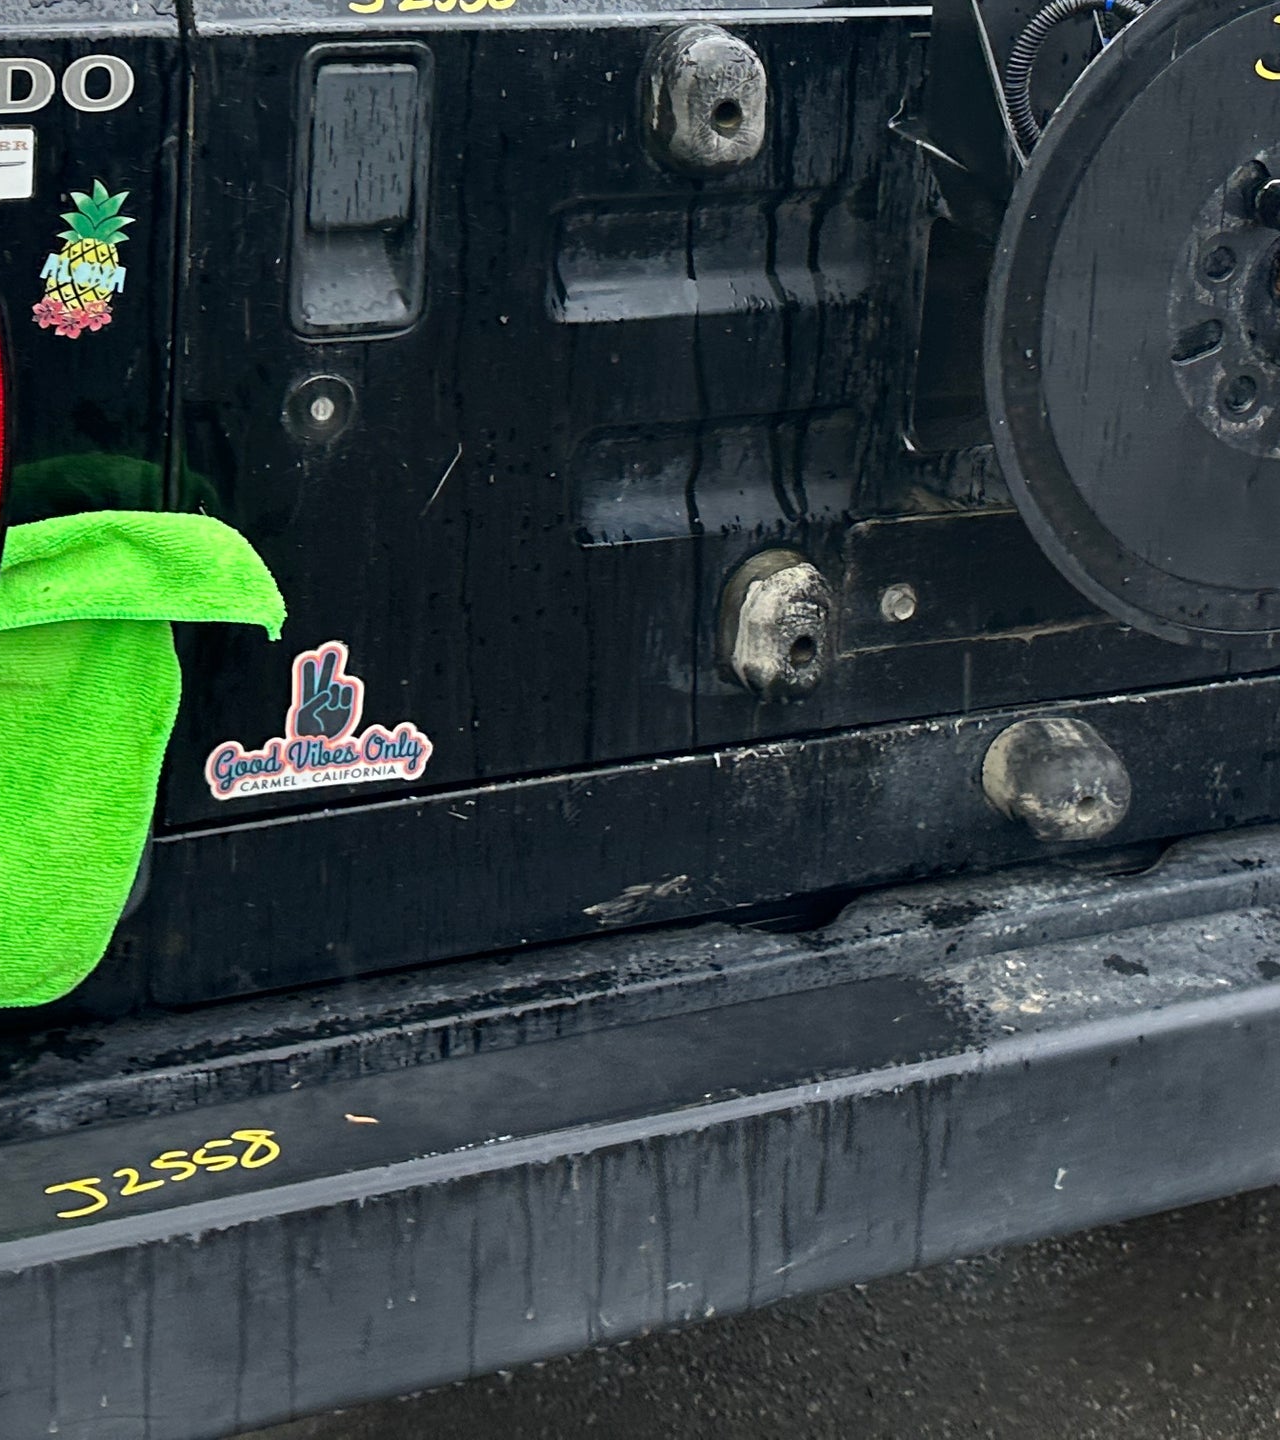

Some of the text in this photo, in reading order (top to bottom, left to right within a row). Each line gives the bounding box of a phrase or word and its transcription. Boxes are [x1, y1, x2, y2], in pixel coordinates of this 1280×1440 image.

[215, 731, 422, 790] Good Vibes Only
[239, 774, 297, 793] CARMEL
[312, 765, 397, 783] CALIFORNIA
[44, 1129, 281, 1219] J2558
